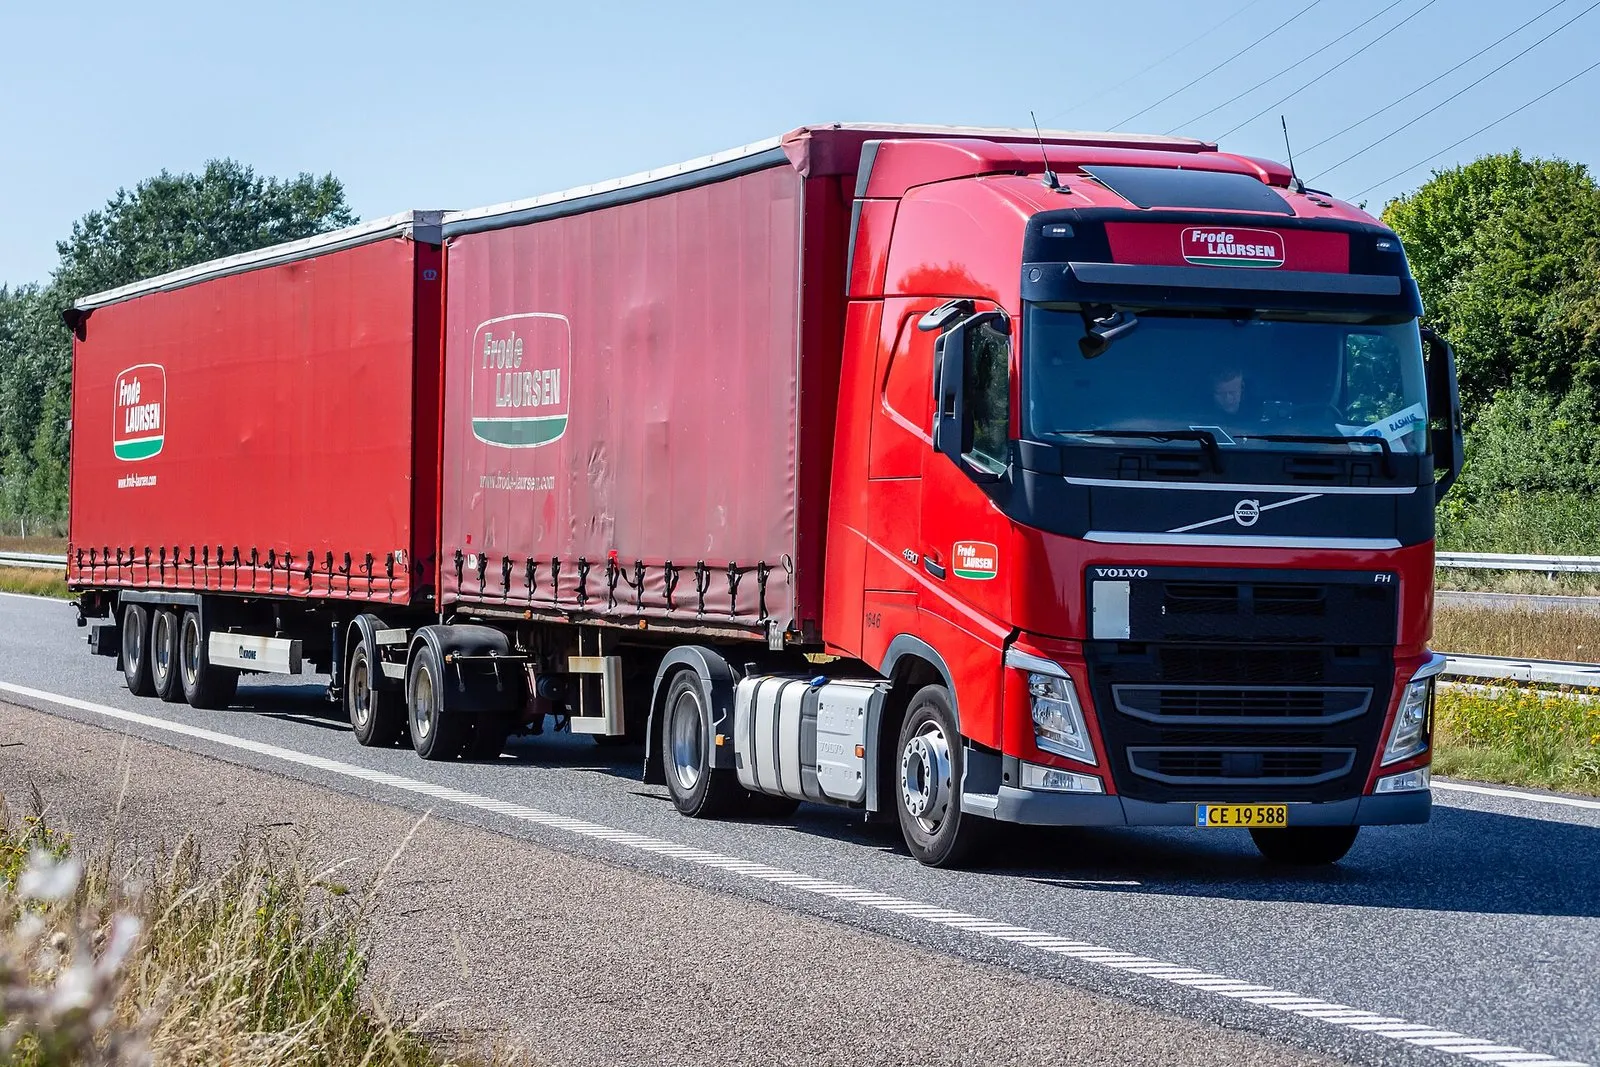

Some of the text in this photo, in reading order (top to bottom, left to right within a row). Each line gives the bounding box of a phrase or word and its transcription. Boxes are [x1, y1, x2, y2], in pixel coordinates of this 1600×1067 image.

[1192, 230, 1234, 243] Frode
[1208, 243, 1275, 257] LAURSEN
[482, 331, 523, 369] Frode
[119, 376, 141, 407] Frode
[495, 368, 561, 408] LAURSEN
[125, 402, 161, 434] LAURSEN
[1388, 413, 1418, 432] RASMUS
[957, 545, 976, 557] Frode
[963, 556, 993, 569] LAURSEN
[1095, 568, 1148, 578] VOLVO
[1374, 574, 1391, 583] FH
[1209, 807, 1285, 824] CE 19 588
